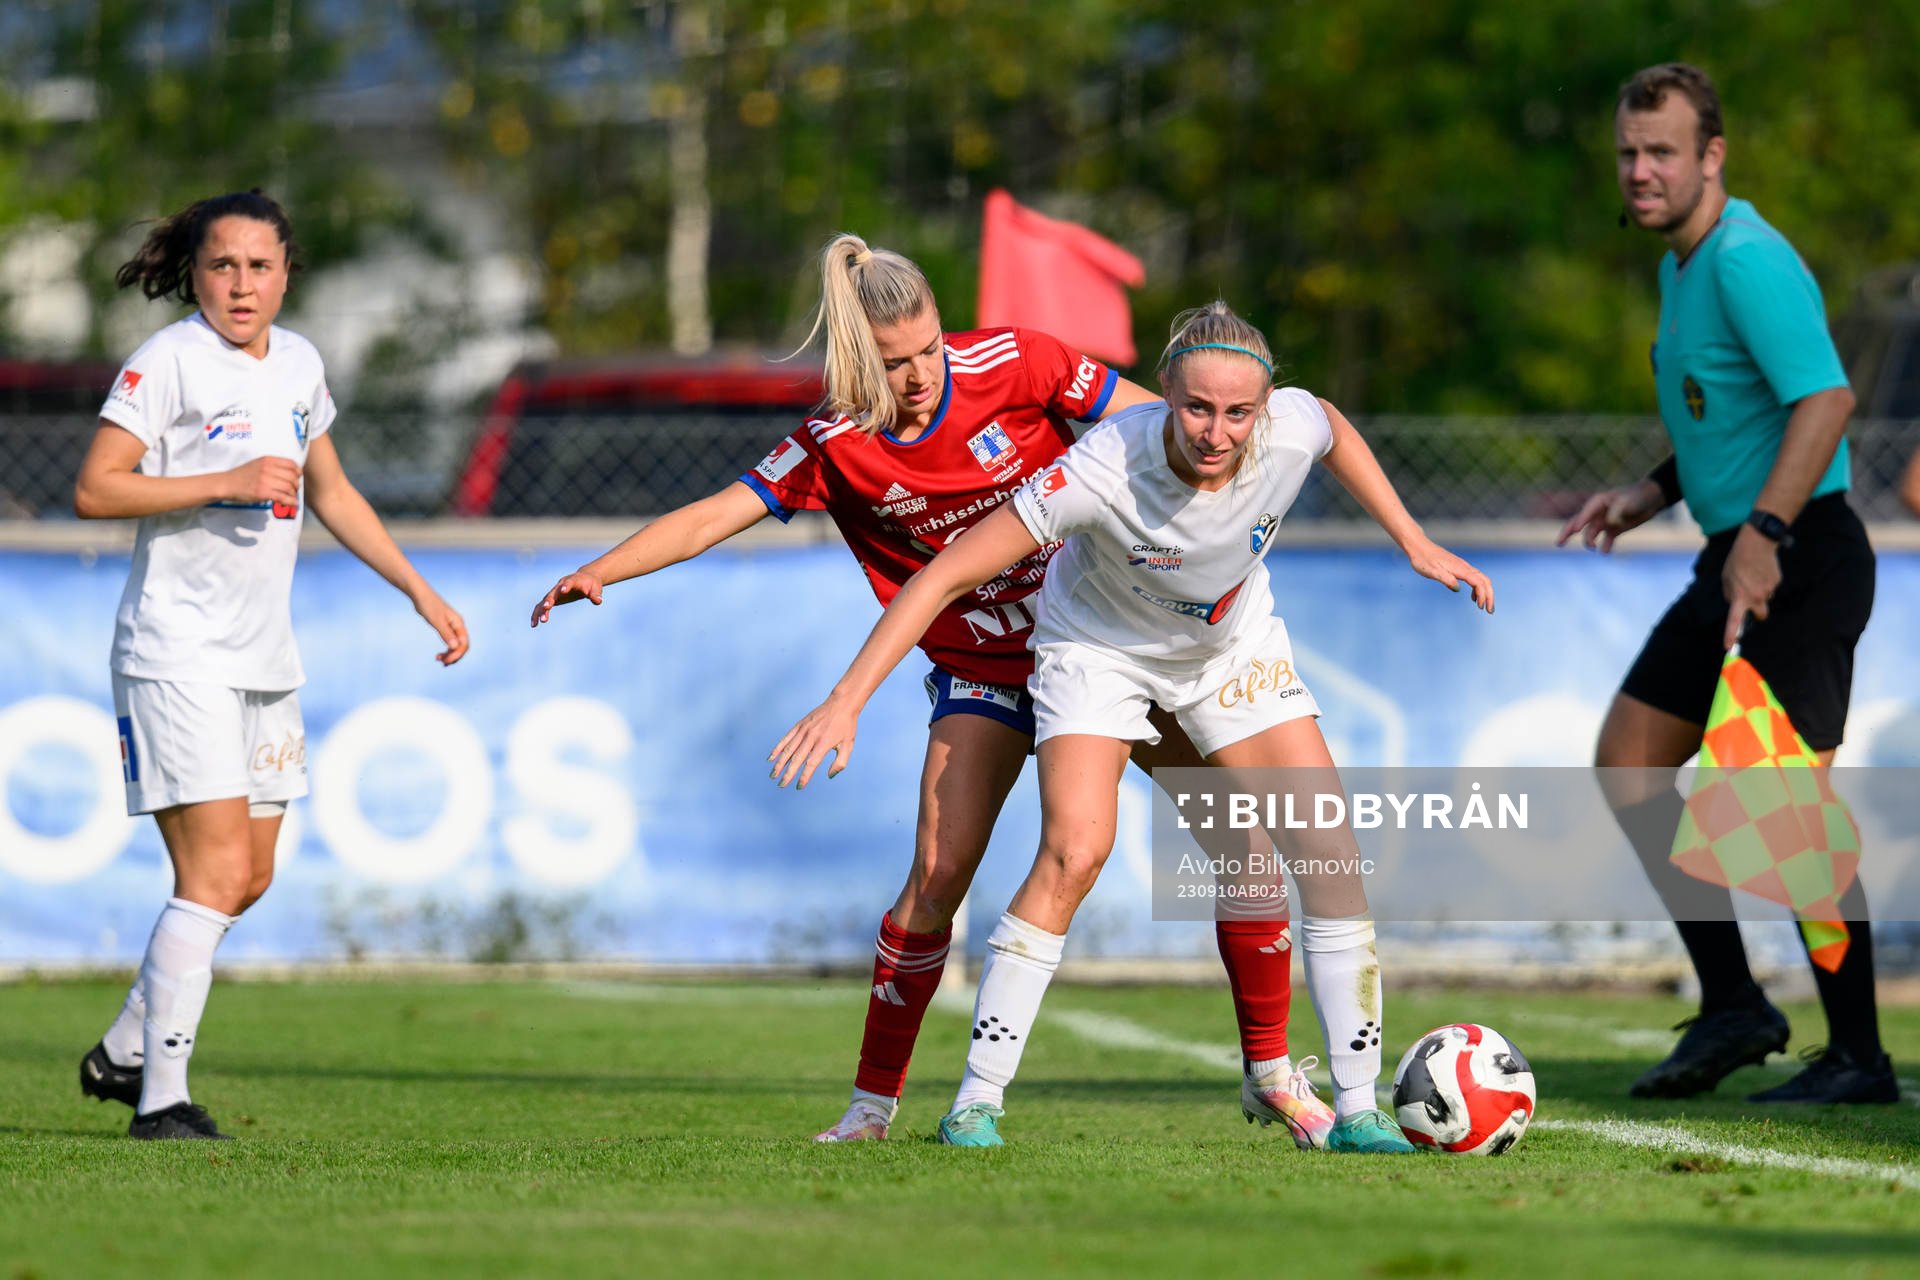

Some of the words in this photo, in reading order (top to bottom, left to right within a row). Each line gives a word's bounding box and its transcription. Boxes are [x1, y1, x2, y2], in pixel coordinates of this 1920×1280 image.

[224, 423, 252, 431] INTER
[225, 431, 253, 440] SPORT
[762, 465, 777, 480] SPEL
[883, 490, 912, 502] adidas
[892, 495, 928, 511] INTER
[896, 502, 928, 517] SPORT
[1035, 499, 1049, 519] SPEL
[1132, 544, 1173, 554] CRAFT
[1148, 557, 1183, 565] INTER
[0, 695, 637, 884] OOS
